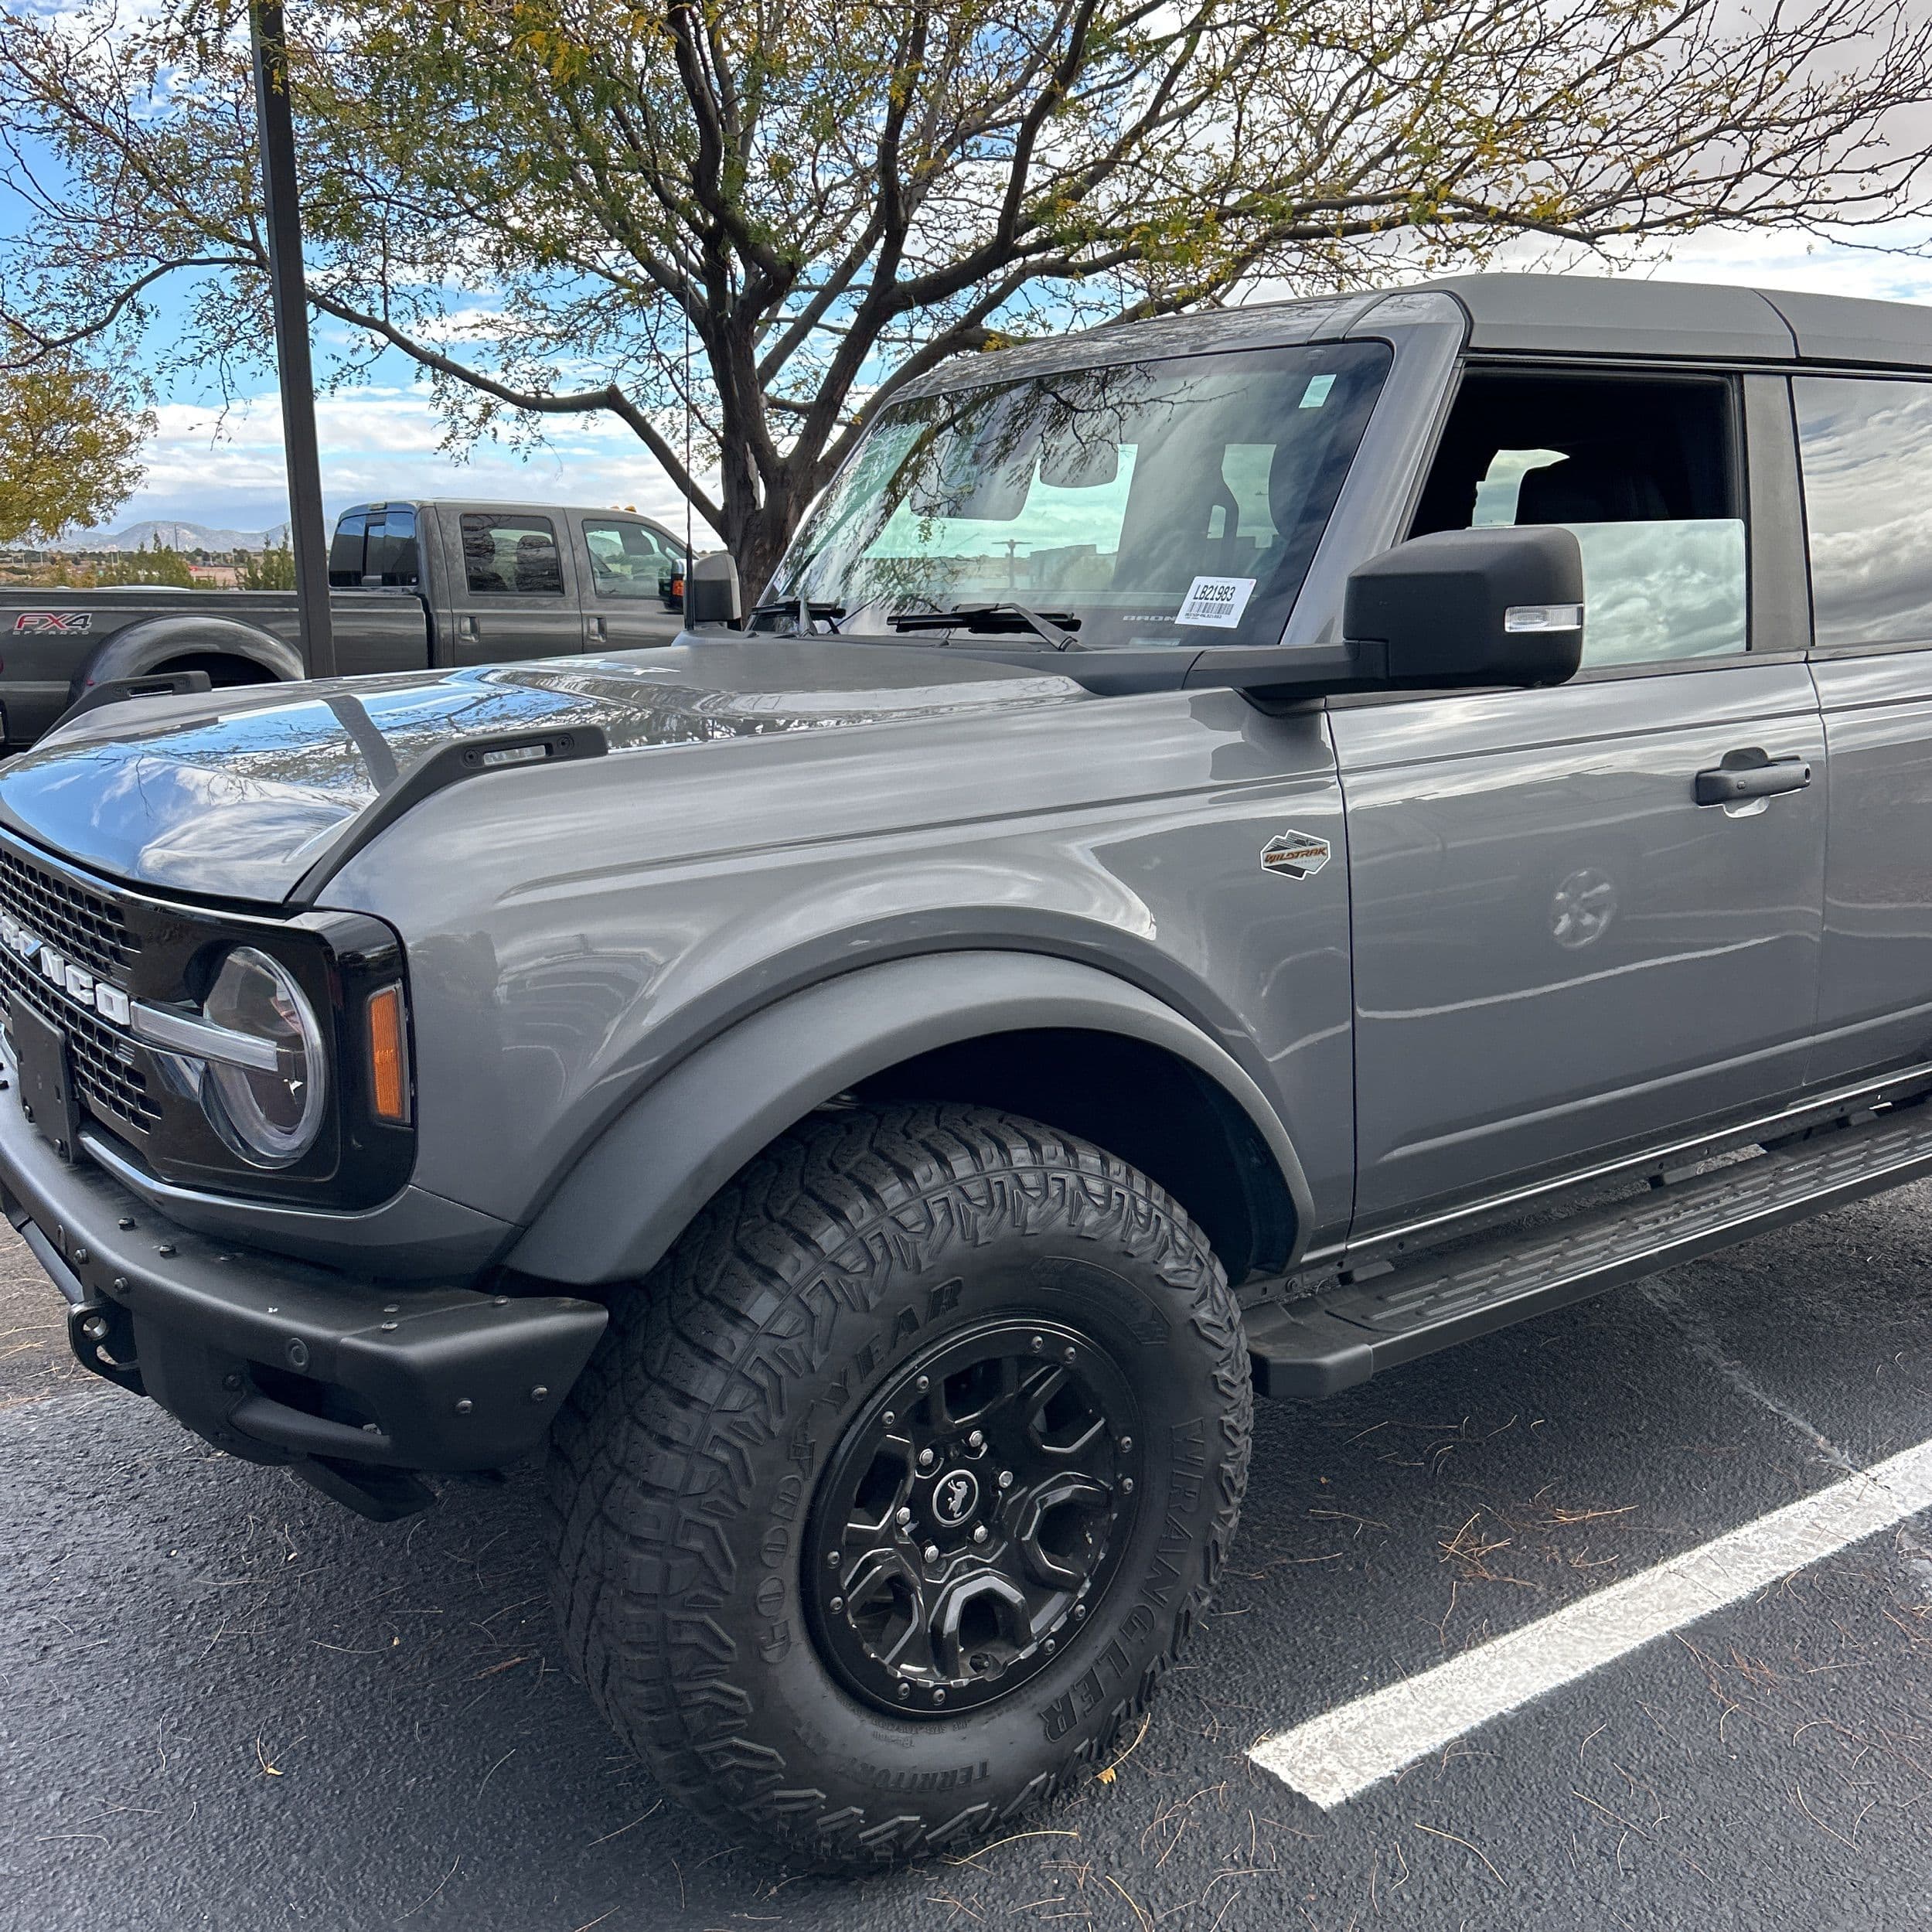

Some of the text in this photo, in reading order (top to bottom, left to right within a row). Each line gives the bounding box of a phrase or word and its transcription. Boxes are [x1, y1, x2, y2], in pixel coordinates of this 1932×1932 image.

[1192, 584, 1235, 601] LB21983
[13, 612, 93, 630] FX4
[1265, 847, 1327, 864] WILDTRAK
[0, 903, 131, 1026] RONCO
[1038, 1416, 1205, 1743] WRANGLER
